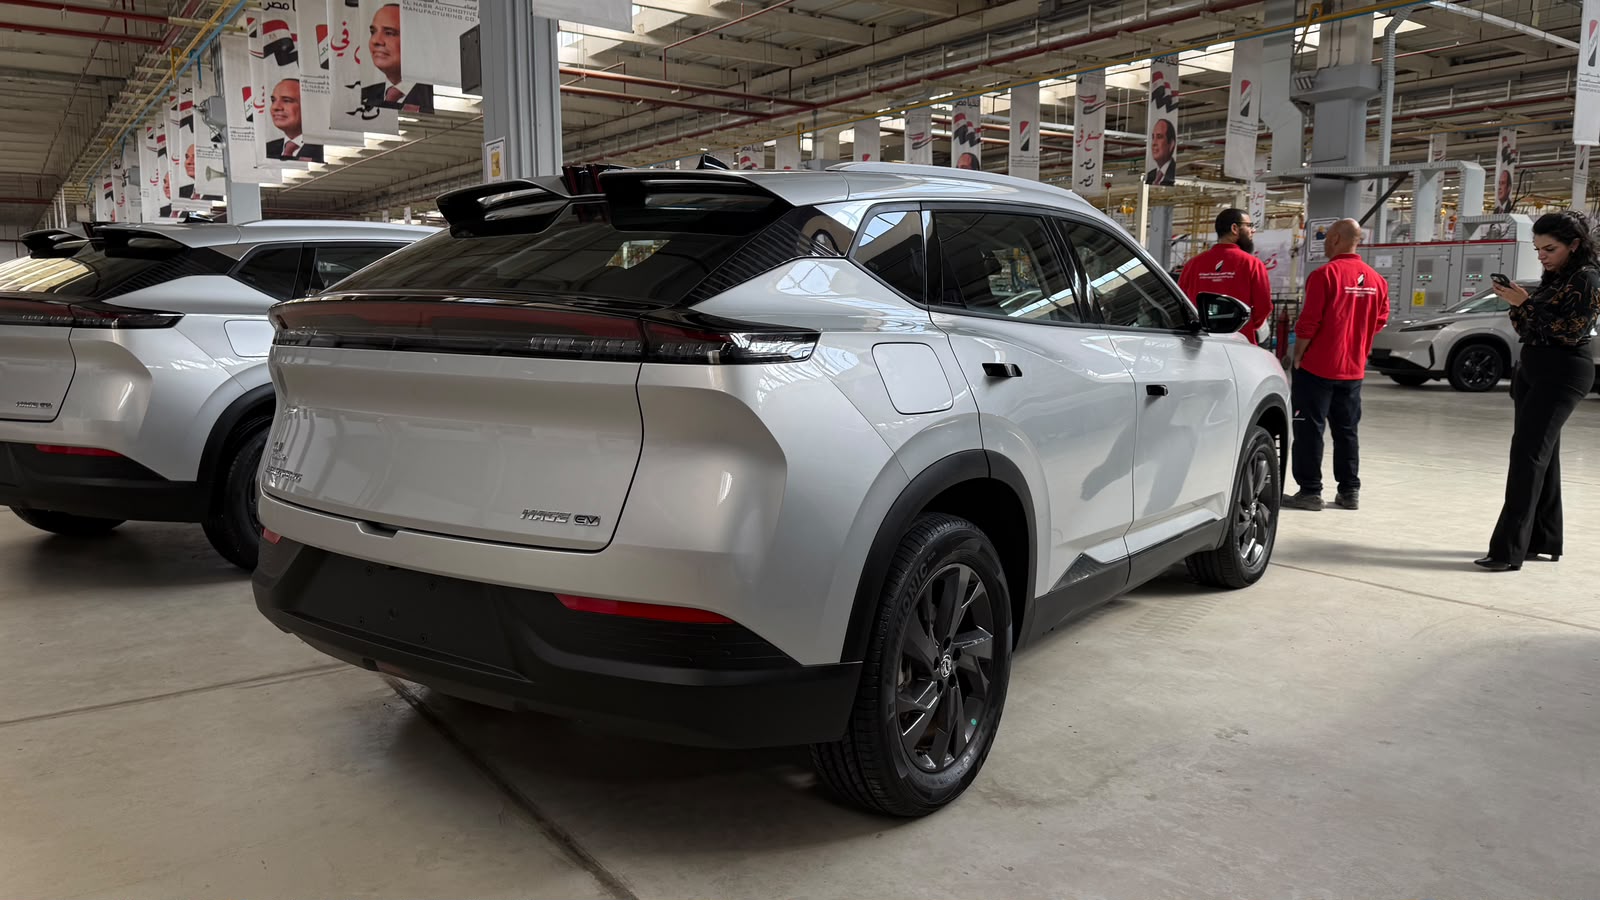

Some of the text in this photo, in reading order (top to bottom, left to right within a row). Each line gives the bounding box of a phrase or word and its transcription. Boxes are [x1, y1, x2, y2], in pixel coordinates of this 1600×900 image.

[402, 5, 463, 20] MANUFACTURING
[434, 5, 477, 17] AUTOMOTIVE
[574, 514, 600, 527] EV
